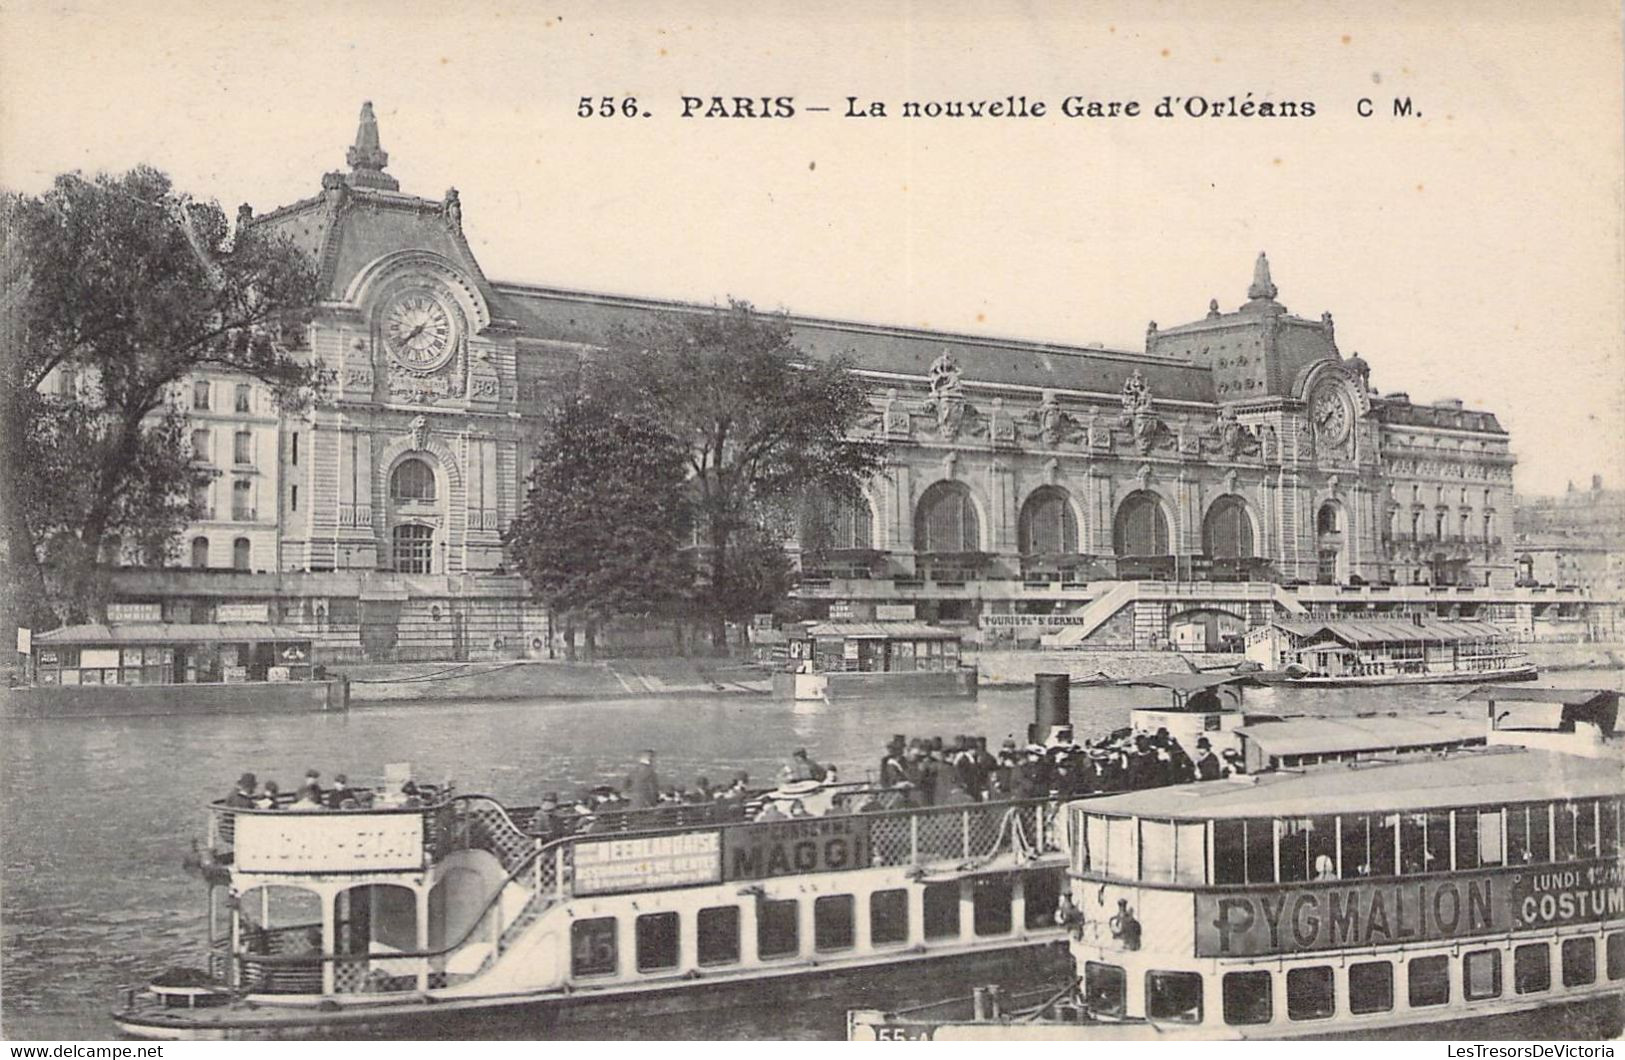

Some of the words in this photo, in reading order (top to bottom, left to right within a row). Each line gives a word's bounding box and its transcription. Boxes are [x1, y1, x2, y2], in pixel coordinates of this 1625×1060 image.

[733, 834, 864, 880] MAGGI
[1532, 870, 1580, 892] LUNDI
[1212, 879, 1494, 953] PYGMALION
[575, 931, 614, 965] 45
